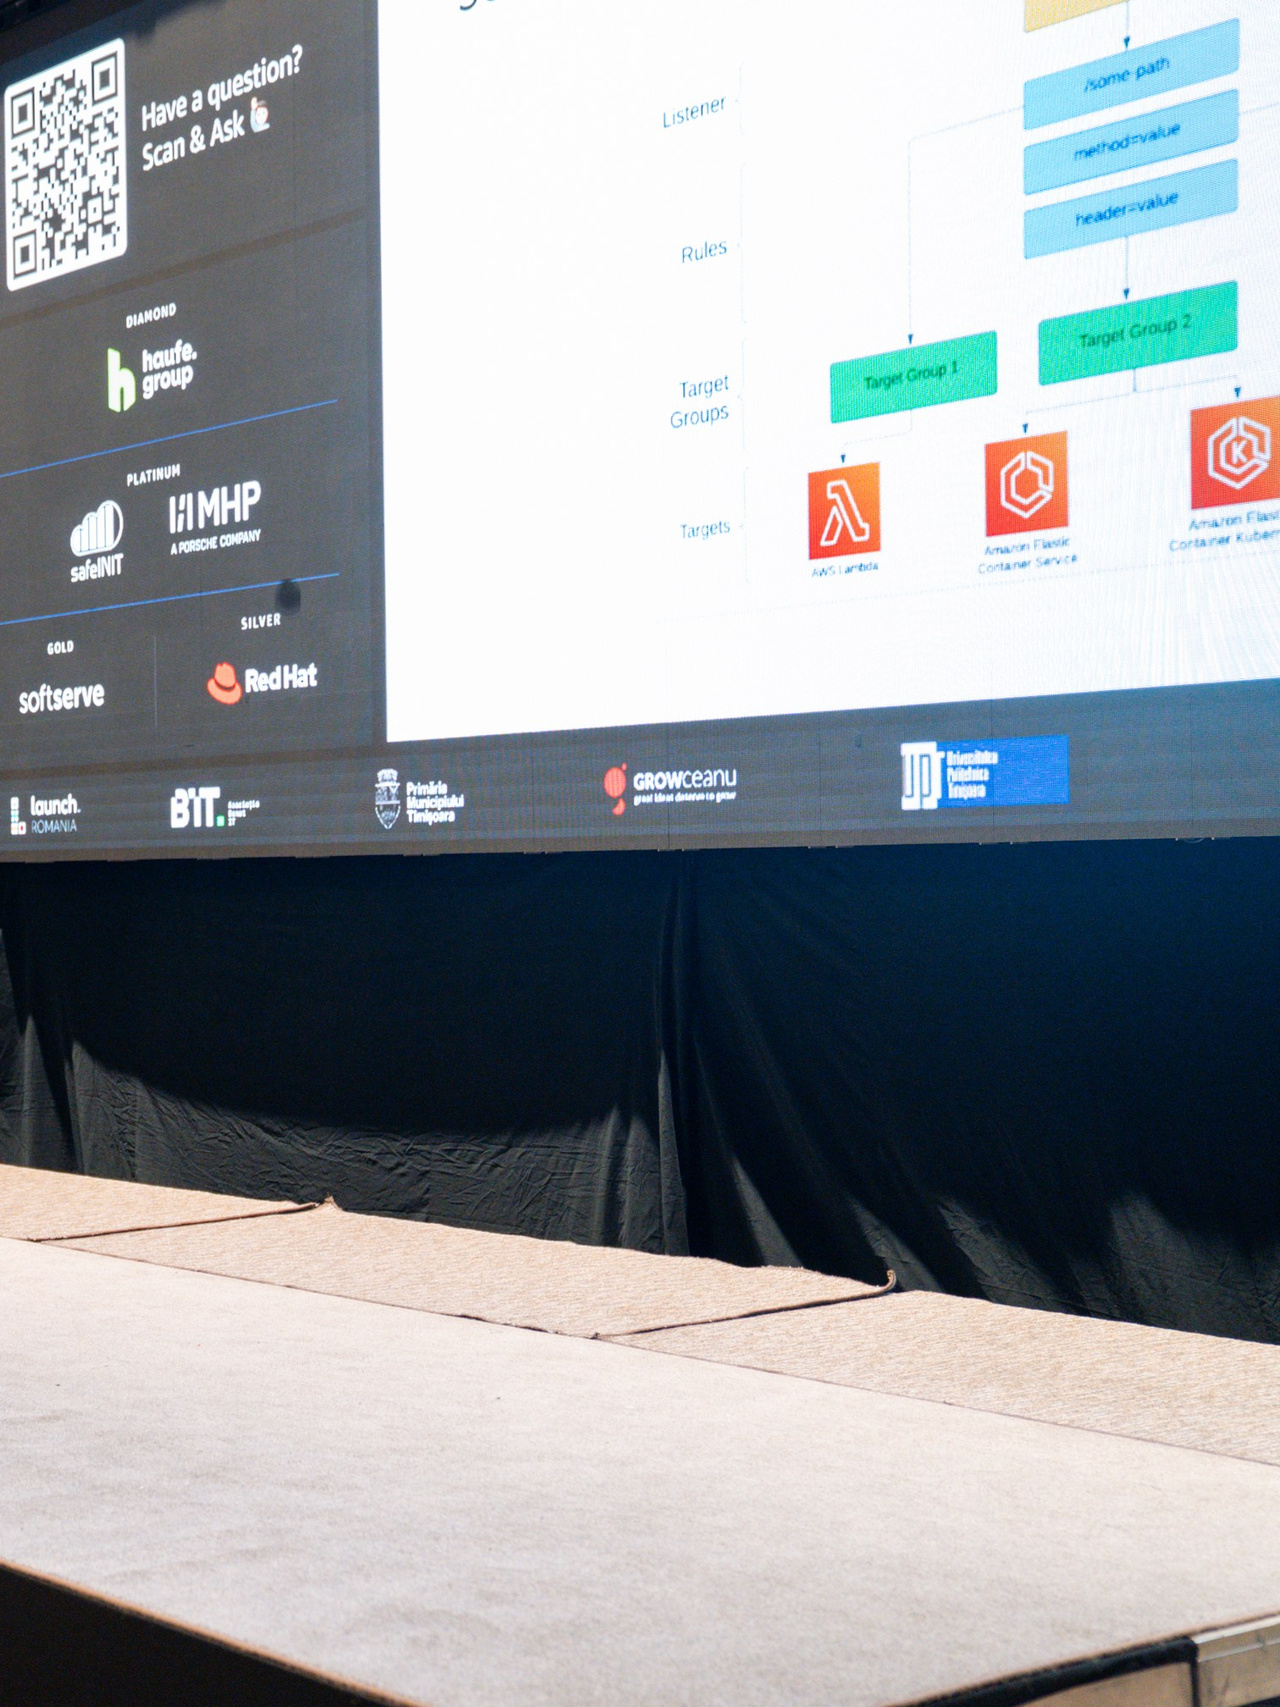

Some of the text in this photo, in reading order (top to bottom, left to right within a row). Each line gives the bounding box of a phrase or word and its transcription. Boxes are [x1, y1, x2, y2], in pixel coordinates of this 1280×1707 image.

[1083, 56, 1171, 92] /some path
[141, 43, 304, 132] Have a question?
[663, 97, 725, 129] Listener
[142, 109, 245, 172] Scan & Ask
[1073, 123, 1181, 161] method=value
[1075, 191, 1179, 227] header=value
[681, 241, 728, 264] Rules
[125, 302, 177, 329] DIAMOND
[1079, 313, 1193, 350] Target Group 2
[141, 364, 194, 400] group
[681, 375, 729, 399] Target
[864, 359, 959, 391] Target Group 1
[670, 405, 729, 429] Groups
[126, 463, 181, 487] PLATINUM
[197, 479, 262, 529] MHP
[681, 521, 731, 539] Targets
[1188, 514, 1243, 531] Amazon
[170, 528, 262, 556] A PORSCHE COMPANY
[984, 543, 1031, 557] Amazon
[1168, 531, 1231, 552] Container
[811, 561, 879, 578] AWS Lambda
[978, 553, 1078, 575] Container Service
[240, 612, 281, 631] SILVER
[46, 640, 75, 656] GOLD
[244, 662, 318, 694] Red Hat
[18, 683, 105, 715] softserve
[405, 779, 449, 796] Primăria
[633, 768, 737, 792] GROWceanu
[405, 793, 465, 810] Municipiului
[31, 818, 78, 834] ROMANIA
